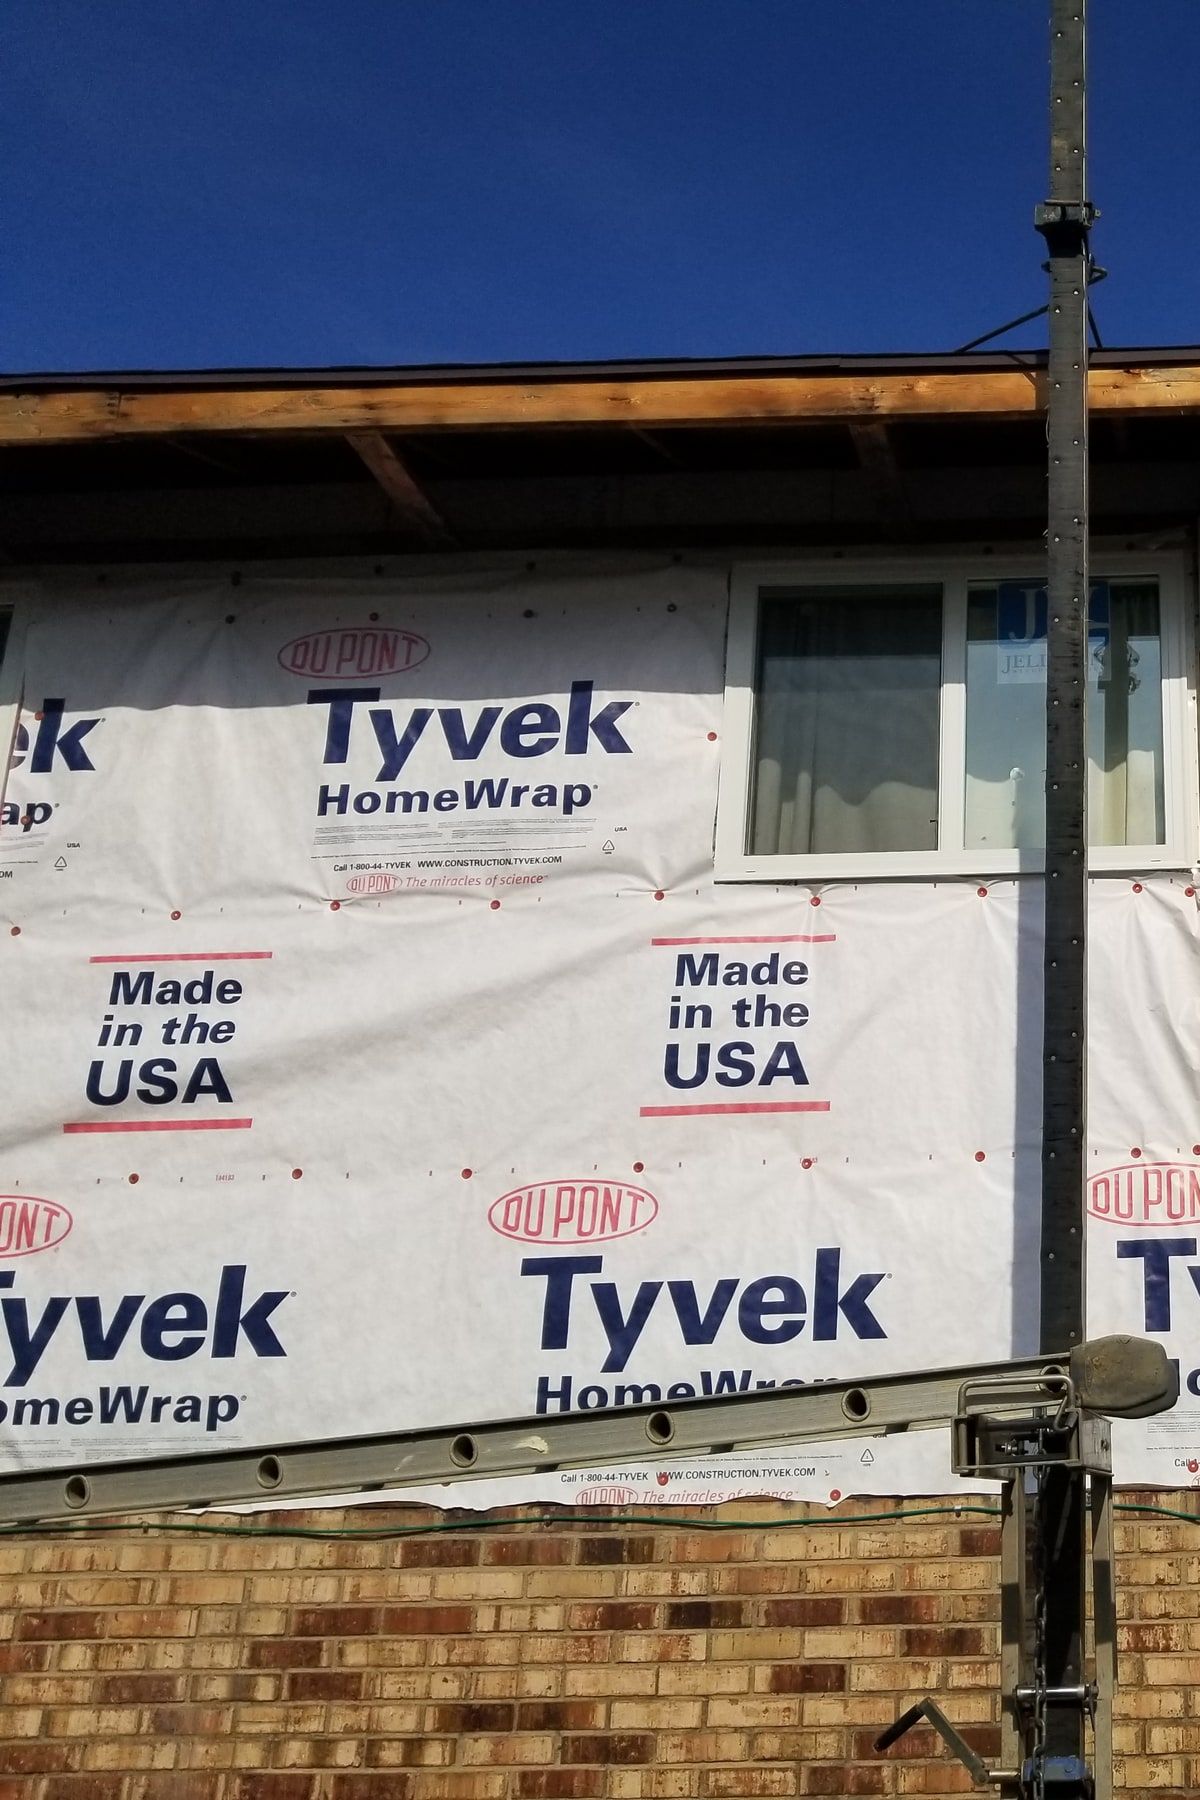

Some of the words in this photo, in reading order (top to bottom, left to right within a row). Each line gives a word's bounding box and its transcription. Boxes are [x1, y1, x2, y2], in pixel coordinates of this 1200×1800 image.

[307, 680, 634, 782] Tyvek
[317, 778, 593, 816] HomeWrap
[333, 864, 348, 872] Call
[350, 861, 411, 871] 1-800-44-TYVEK
[417, 856, 562, 868] WWW.CONSTRUCTION.TYVEK.COM
[406, 877, 427, 887] The
[429, 875, 481, 886] miracles
[485, 875, 499, 887] of
[500, 874, 544, 885] science
[675, 953, 809, 987] Made
[109, 971, 242, 1005] Made
[669, 996, 712, 1029] in
[732, 994, 809, 1028] the
[97, 1015, 143, 1046] in
[161, 1014, 236, 1045] the
[86, 1058, 234, 1106] USA
[664, 1042, 810, 1089] USA
[0, 1264, 291, 1387] yvek
[520, 1247, 889, 1373] Tyvek
[560, 1474, 577, 1483] Call
[579, 1472, 649, 1482] 1-800-44-TYVEK
[643, 1490, 665, 1503] The
[668, 1489, 724, 1502] miracles
